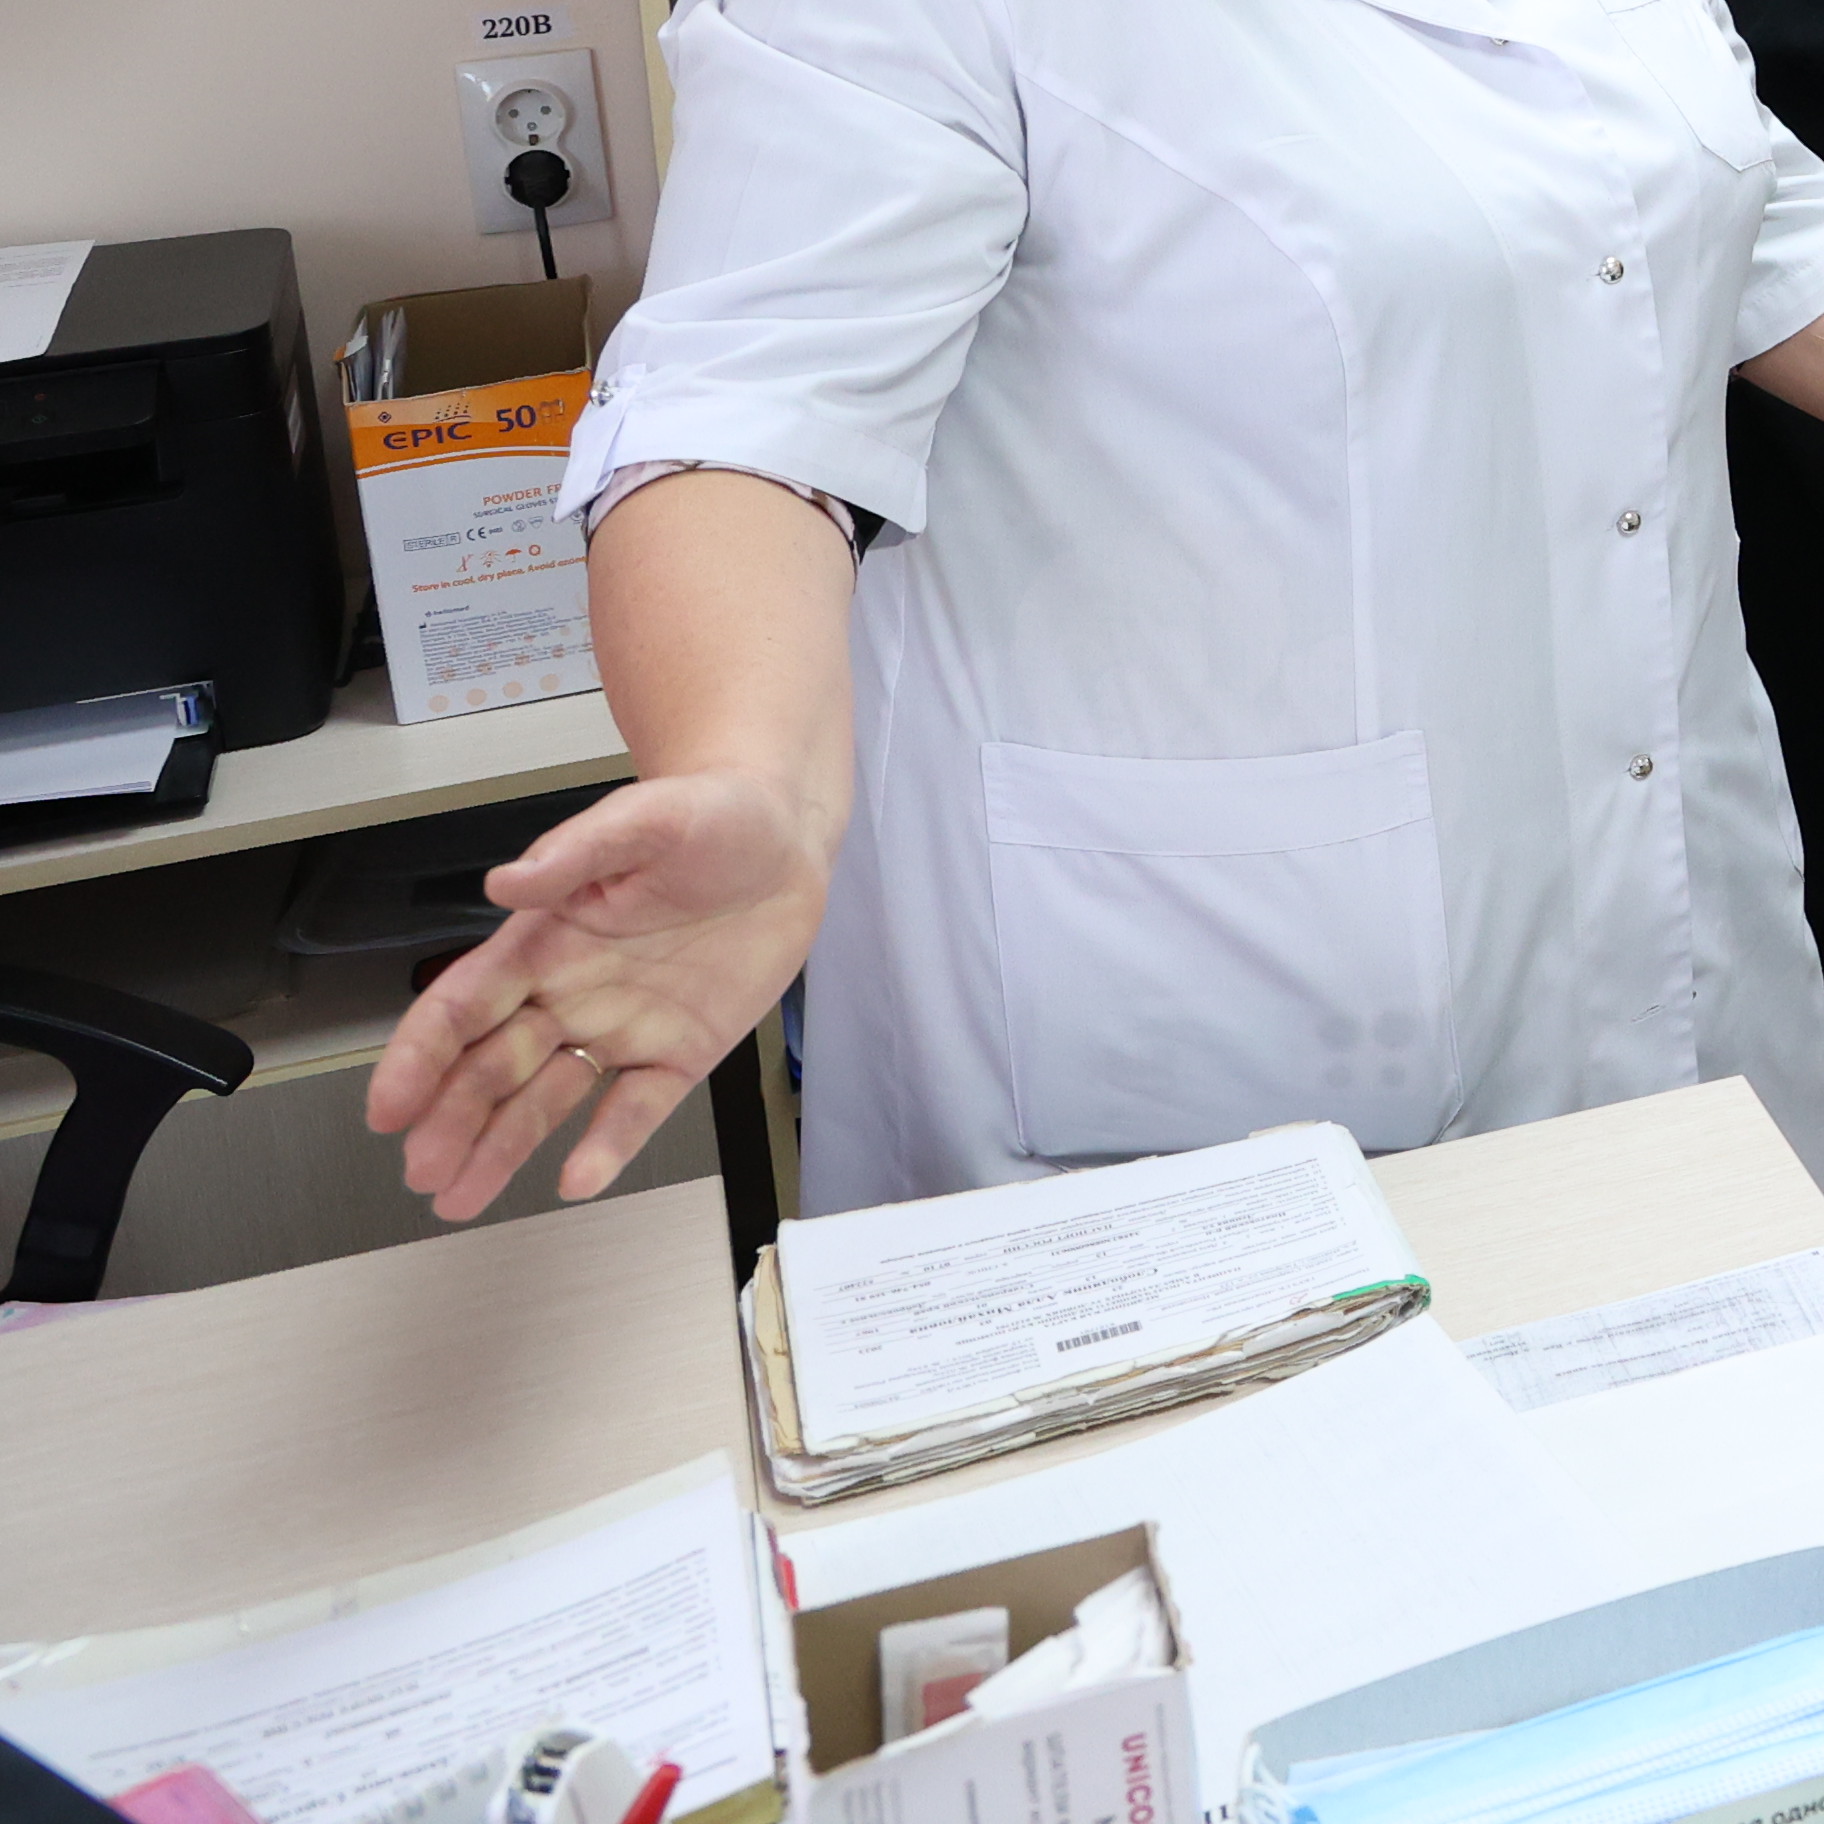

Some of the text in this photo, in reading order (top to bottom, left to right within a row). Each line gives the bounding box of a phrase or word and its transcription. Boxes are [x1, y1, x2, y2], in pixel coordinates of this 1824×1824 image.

[496, 405, 537, 433] 50
[383, 421, 473, 451] EPIC
[483, 487, 543, 507] POWDER
[515, 499, 548, 512] GLOVES
[412, 582, 440, 594] Store
[440, 580, 451, 590] in
[477, 571, 496, 584] dry
[527, 559, 556, 573] Avoid
